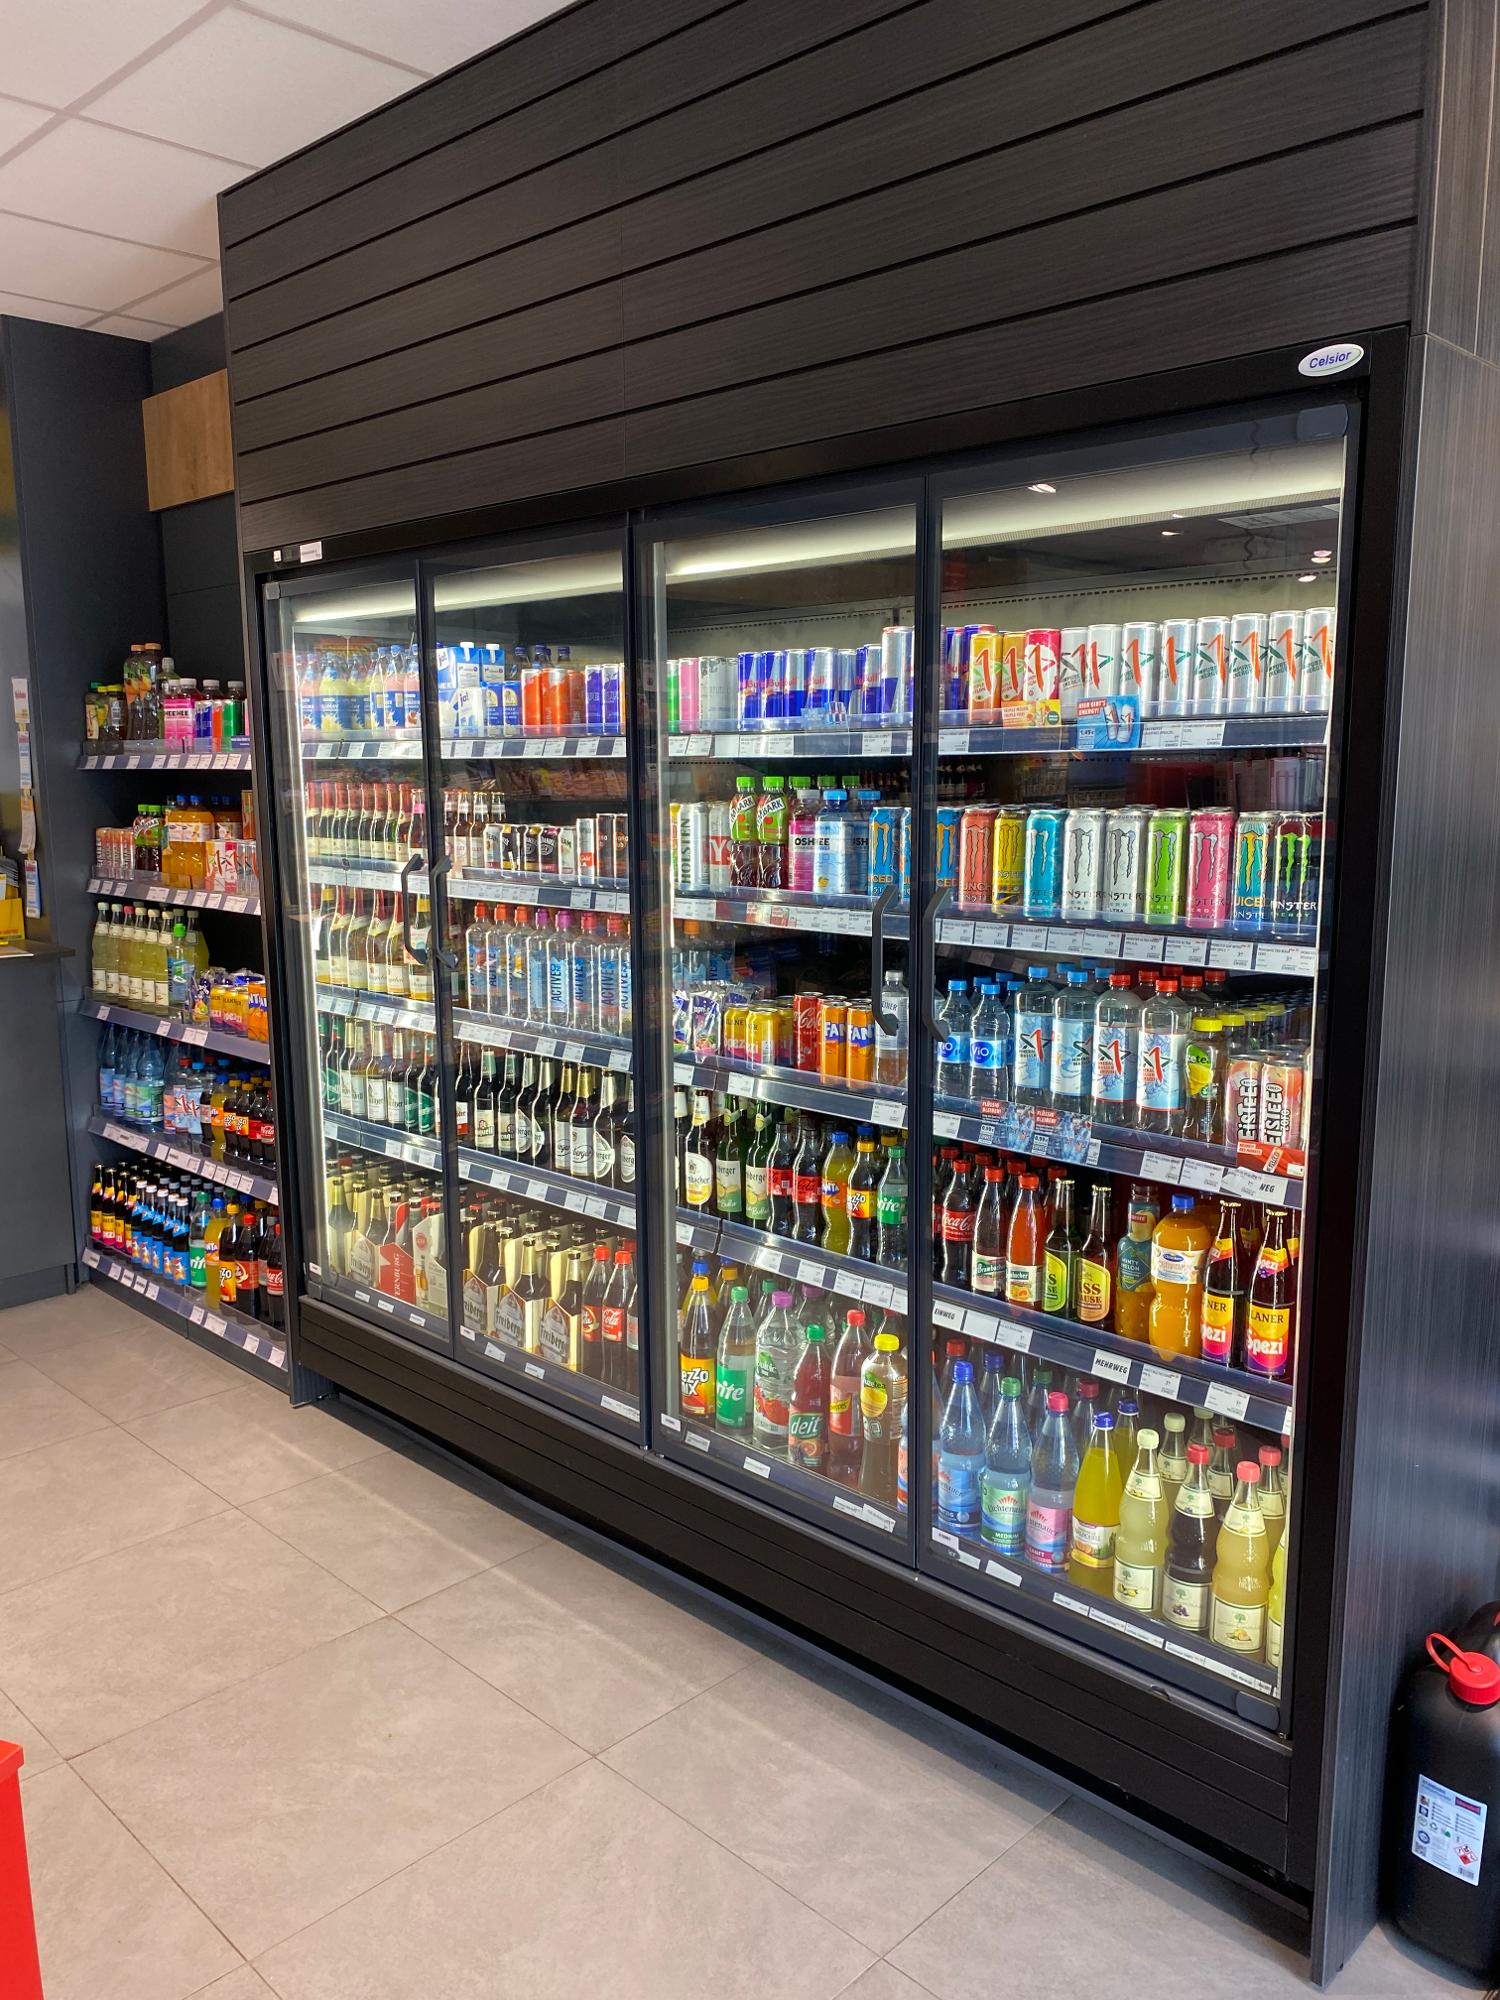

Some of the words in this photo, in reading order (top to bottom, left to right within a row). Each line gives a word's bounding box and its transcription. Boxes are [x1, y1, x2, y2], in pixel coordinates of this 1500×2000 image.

[1309, 351, 1352, 369] Celsior
[680, 818, 691, 885] HOLSTEN
[1095, 1358, 1128, 1375] MEHRWEG
[791, 1416, 822, 1436] deit
